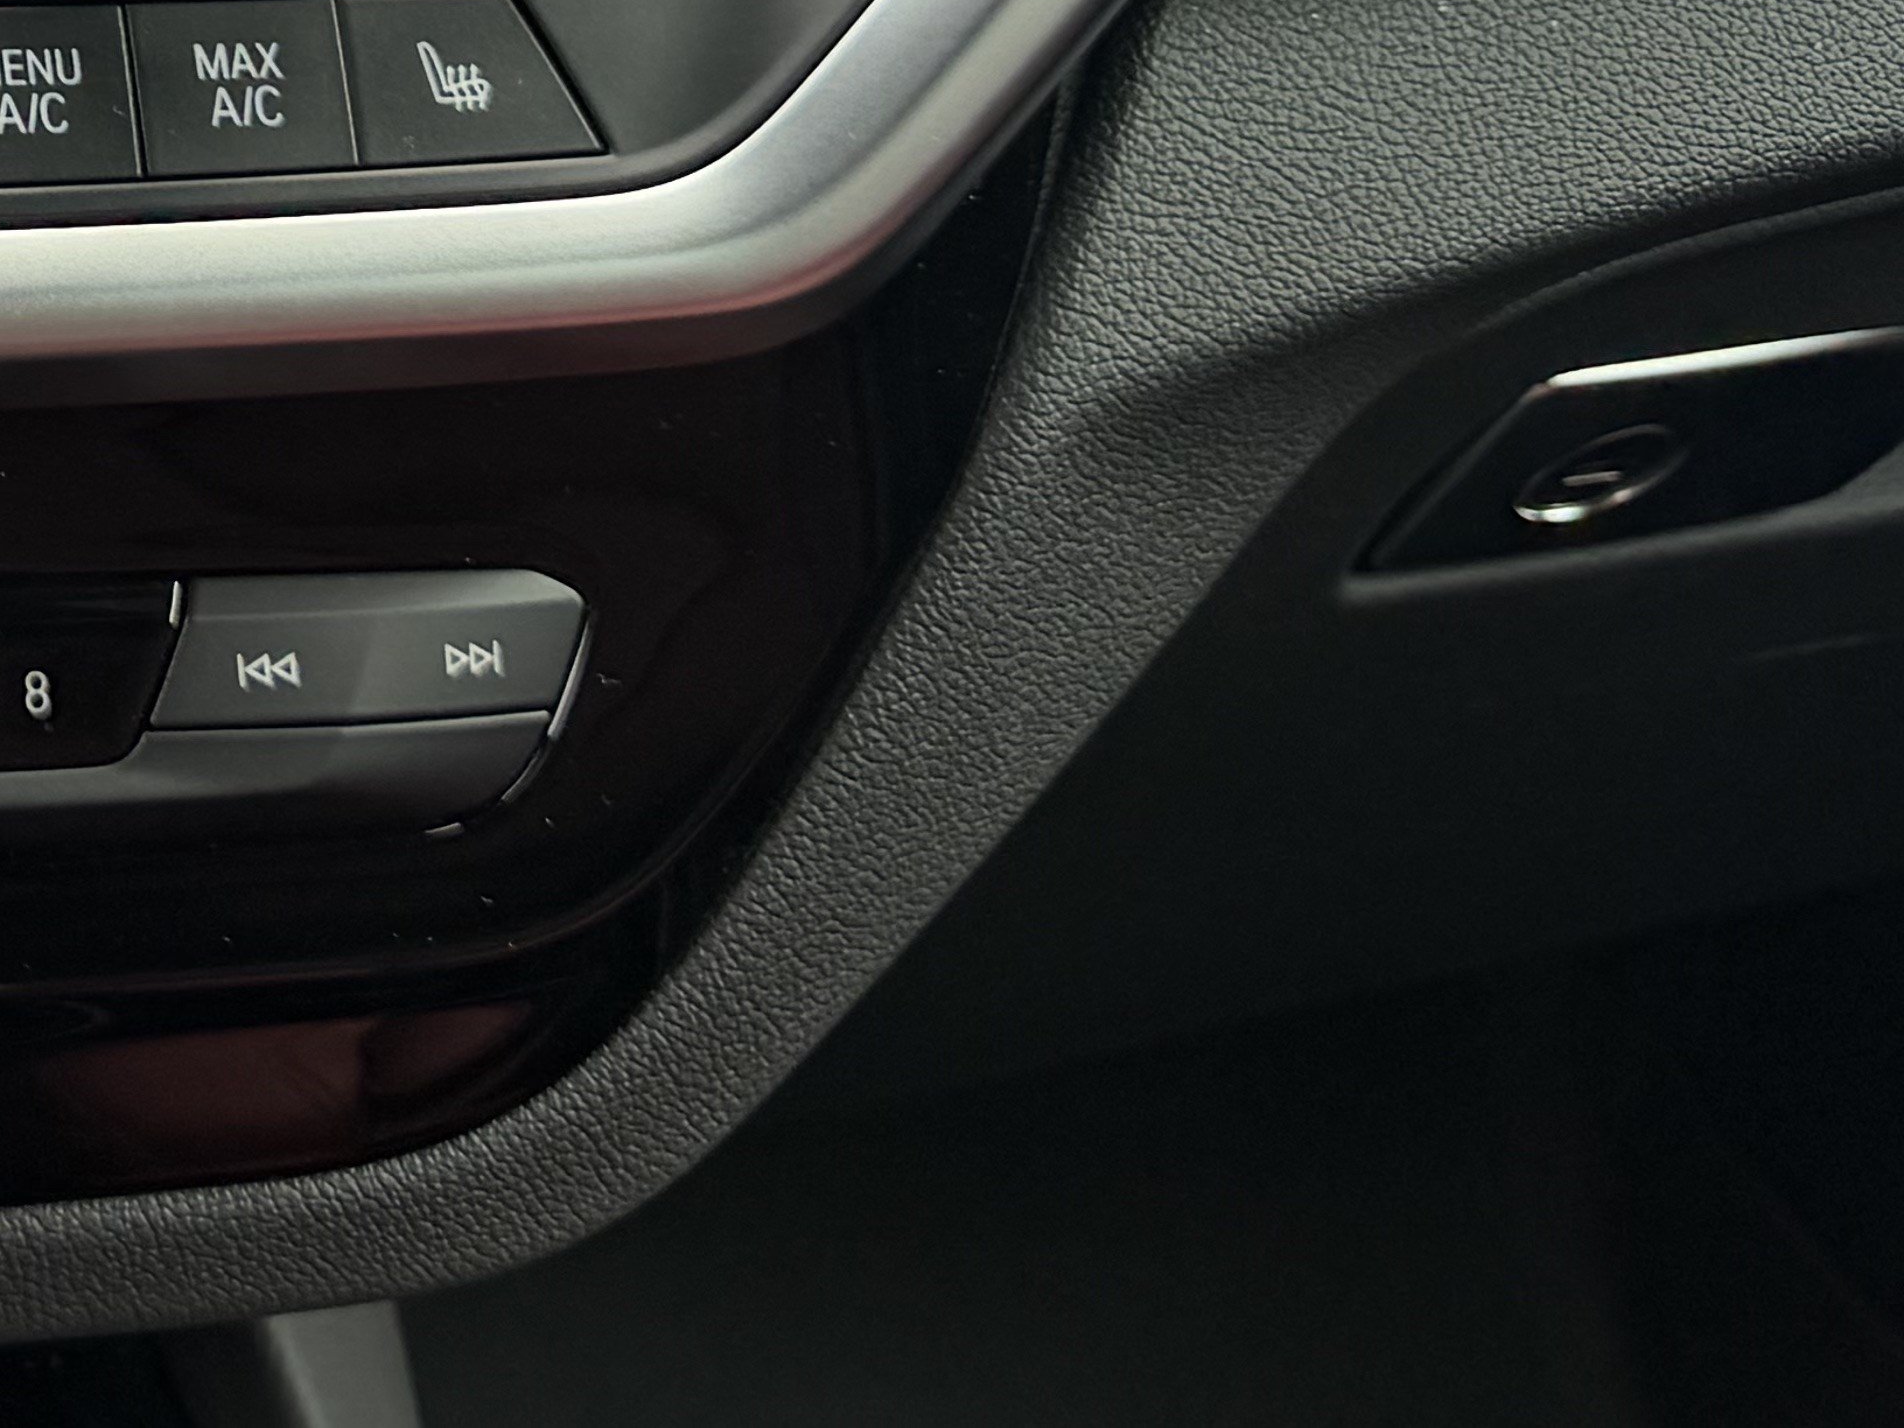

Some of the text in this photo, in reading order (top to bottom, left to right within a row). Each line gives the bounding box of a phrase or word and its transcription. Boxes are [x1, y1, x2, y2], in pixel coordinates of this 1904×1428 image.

[192, 42, 284, 82] MAX
[212, 84, 285, 129] A/C
[24, 670, 53, 721] 8
